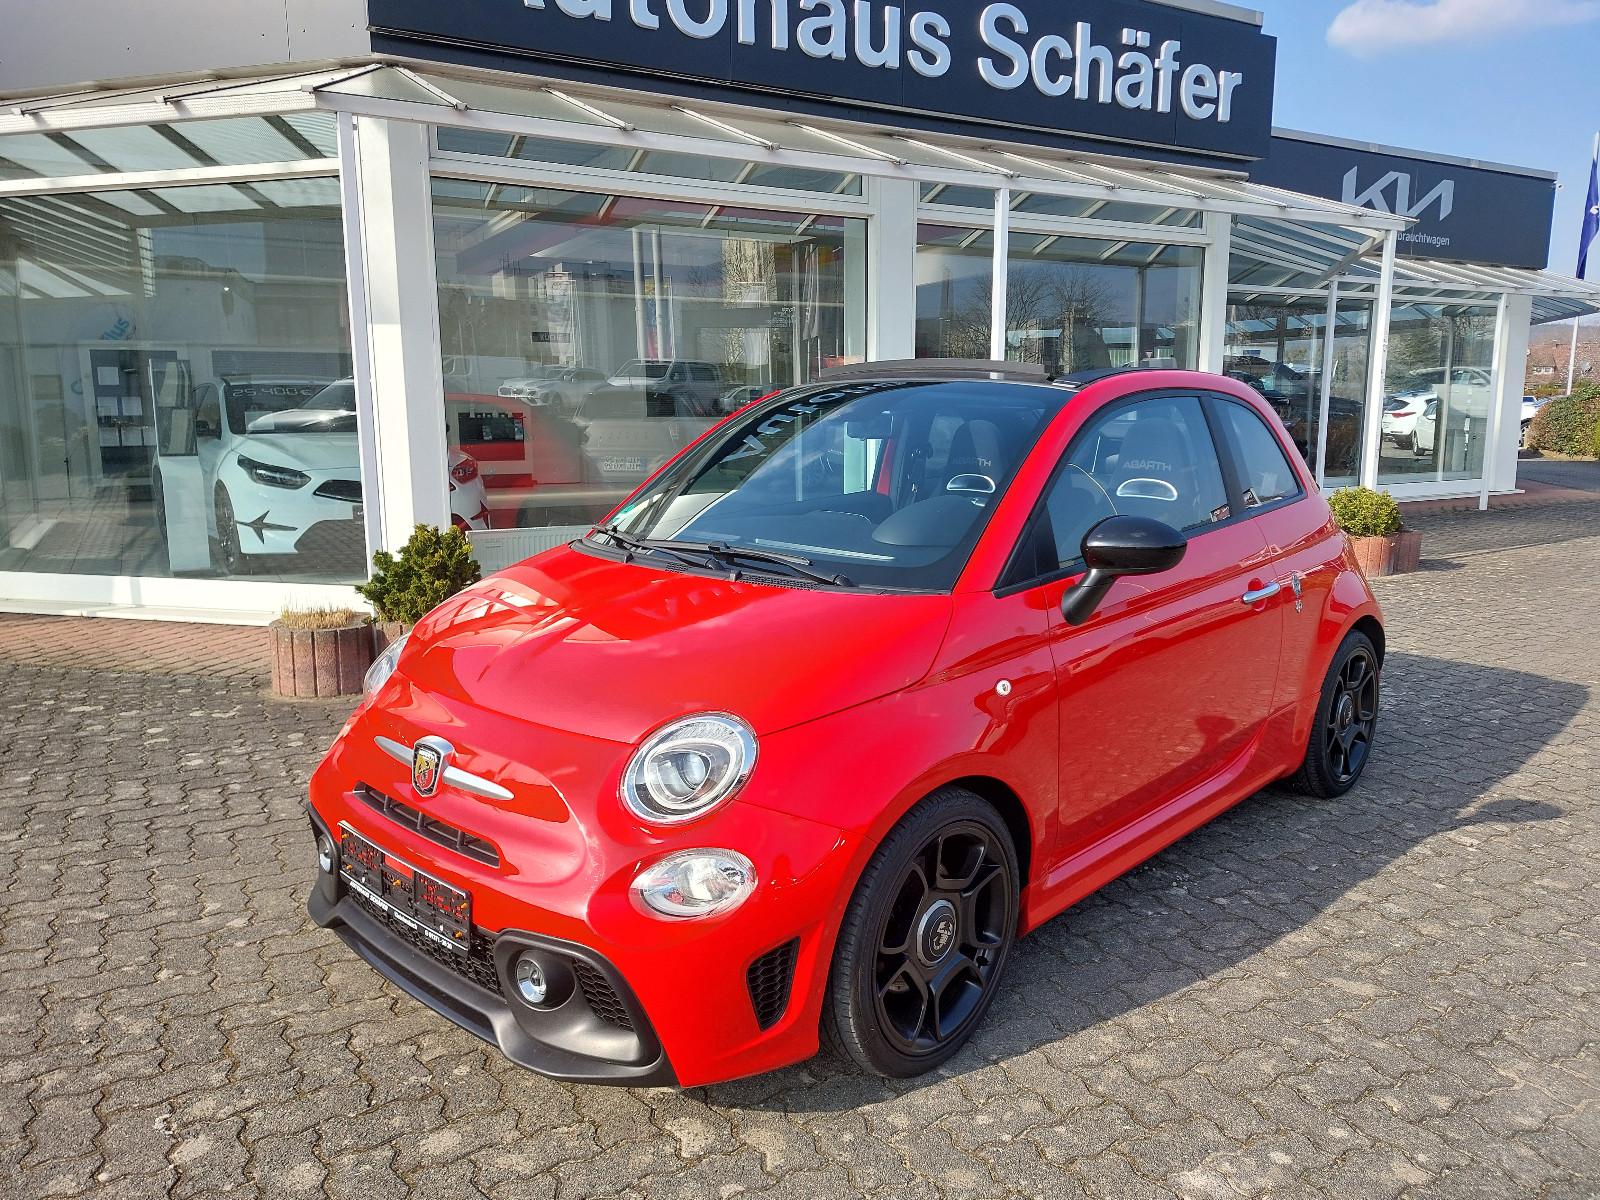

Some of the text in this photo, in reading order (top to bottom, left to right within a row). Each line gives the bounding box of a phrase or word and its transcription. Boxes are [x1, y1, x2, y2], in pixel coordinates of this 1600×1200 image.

[978, 2, 1243, 123] Schäfer
[1341, 165, 1455, 221] KIA
[1397, 231, 1450, 248] brauchtwagen
[261, 388, 297, 396] 400
[1123, 460, 1172, 472] ABARTH
